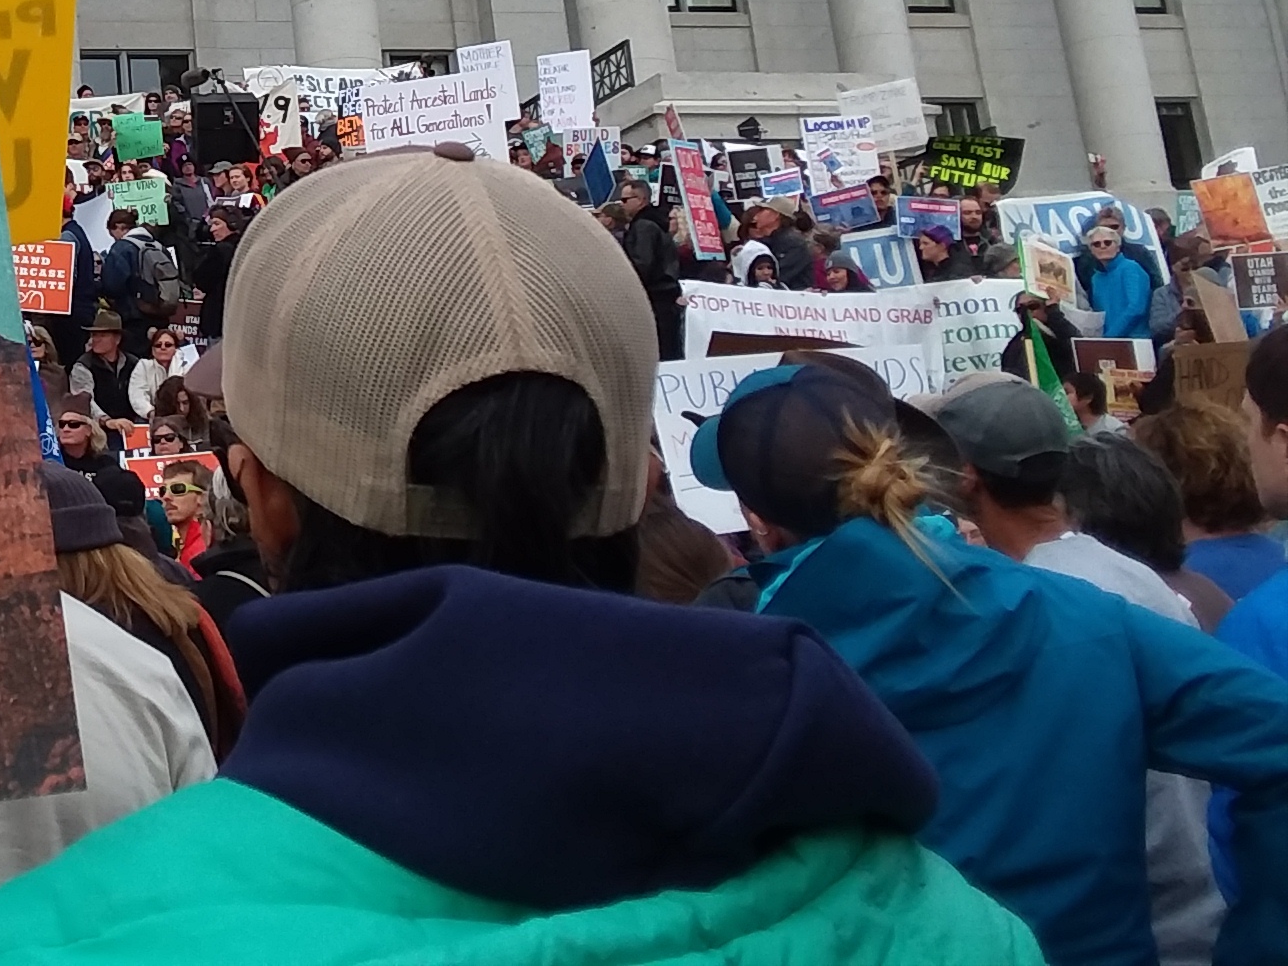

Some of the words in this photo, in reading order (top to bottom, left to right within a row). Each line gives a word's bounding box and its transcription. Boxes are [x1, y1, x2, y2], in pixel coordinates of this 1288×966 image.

[459, 46, 504, 64] MOTHER
[364, 92, 404, 117] Protect
[410, 81, 459, 110] Ancestral
[461, 77, 497, 103] Lands
[369, 124, 387, 141] for
[390, 115, 415, 137] ALL
[417, 103, 492, 134] Generations!
[566, 141, 620, 156] BRIDES
[941, 154, 977, 170] SAVE
[982, 161, 1011, 180] OUR
[140, 203, 158, 215] OUR
[1047, 199, 1144, 248] ACU
[12, 255, 51, 265] RAND
[849, 241, 905, 287] LU
[1247, 256, 1274, 269] UTAH
[18, 278, 66, 290] LANTE
[688, 294, 730, 312] STOP
[732, 299, 764, 317] THE
[768, 303, 827, 322] INDIAN
[832, 307, 881, 324] LAND
[886, 308, 933, 325] GRAB
